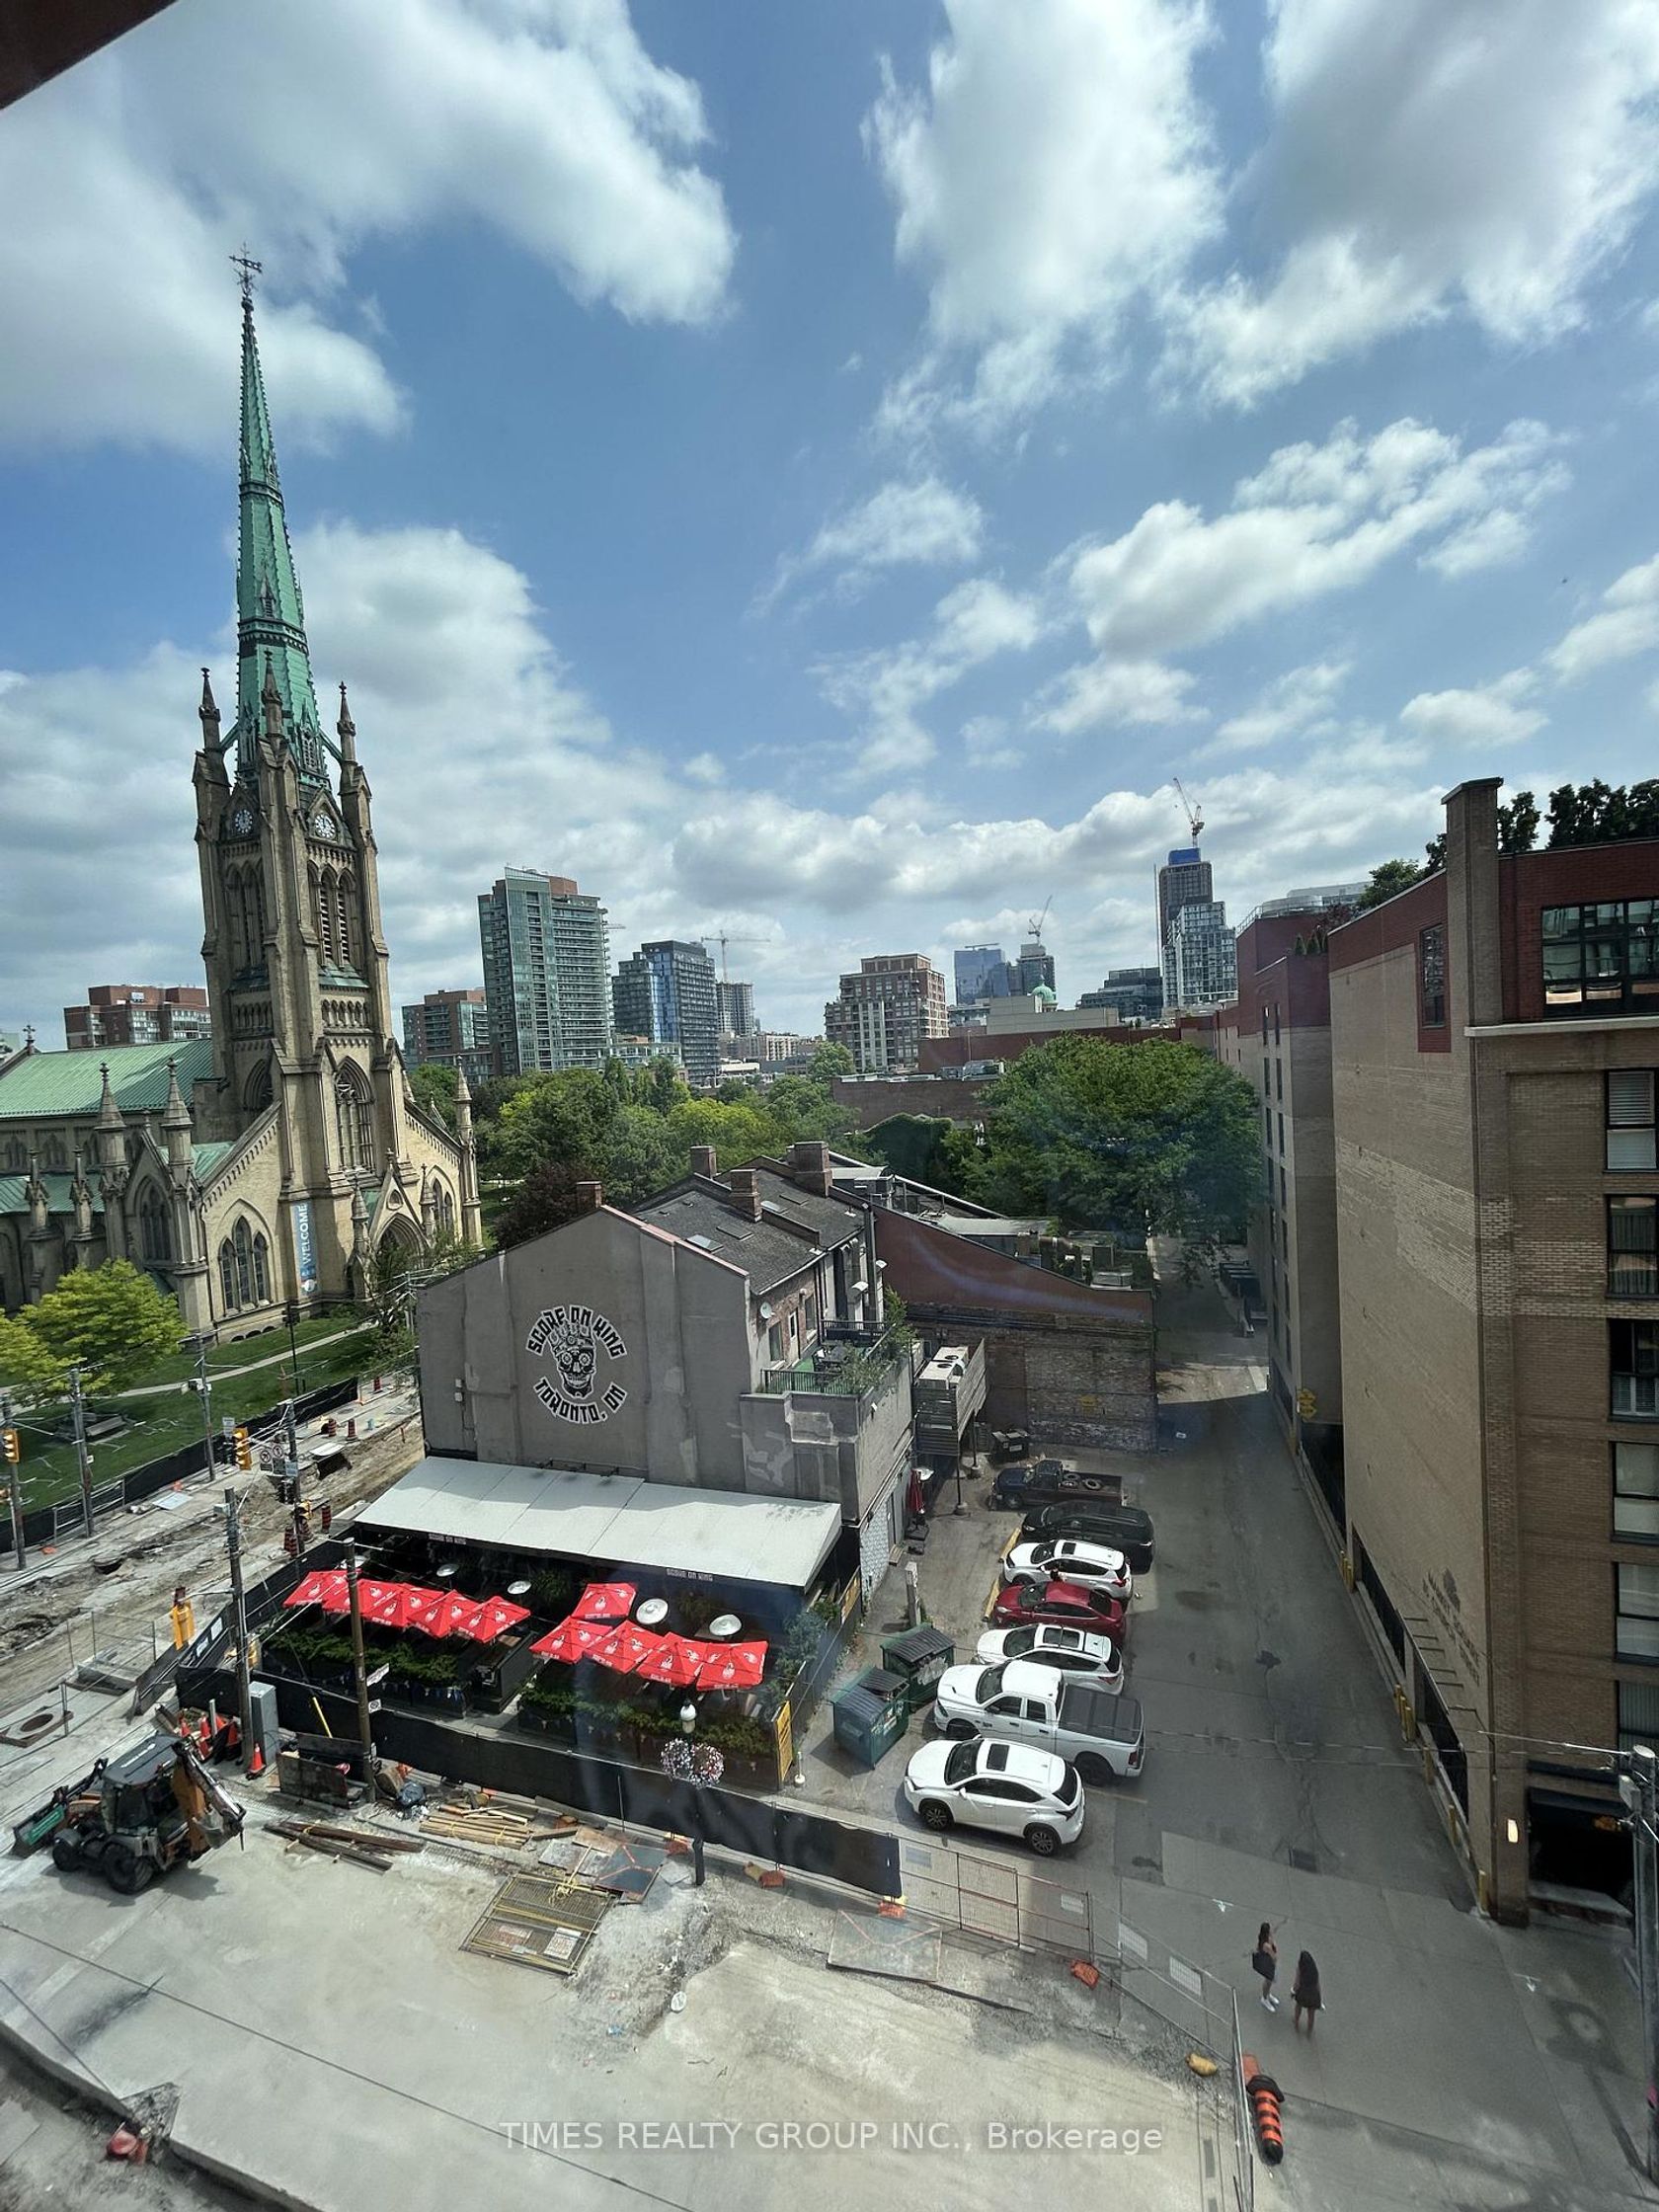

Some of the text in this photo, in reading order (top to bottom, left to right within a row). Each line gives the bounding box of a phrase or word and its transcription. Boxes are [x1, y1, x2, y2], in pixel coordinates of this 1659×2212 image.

[298, 1203, 312, 1265] WELCOME
[525, 1304, 628, 1360] SCORE ON KING
[533, 1376, 628, 1425] TORONTO, ON
